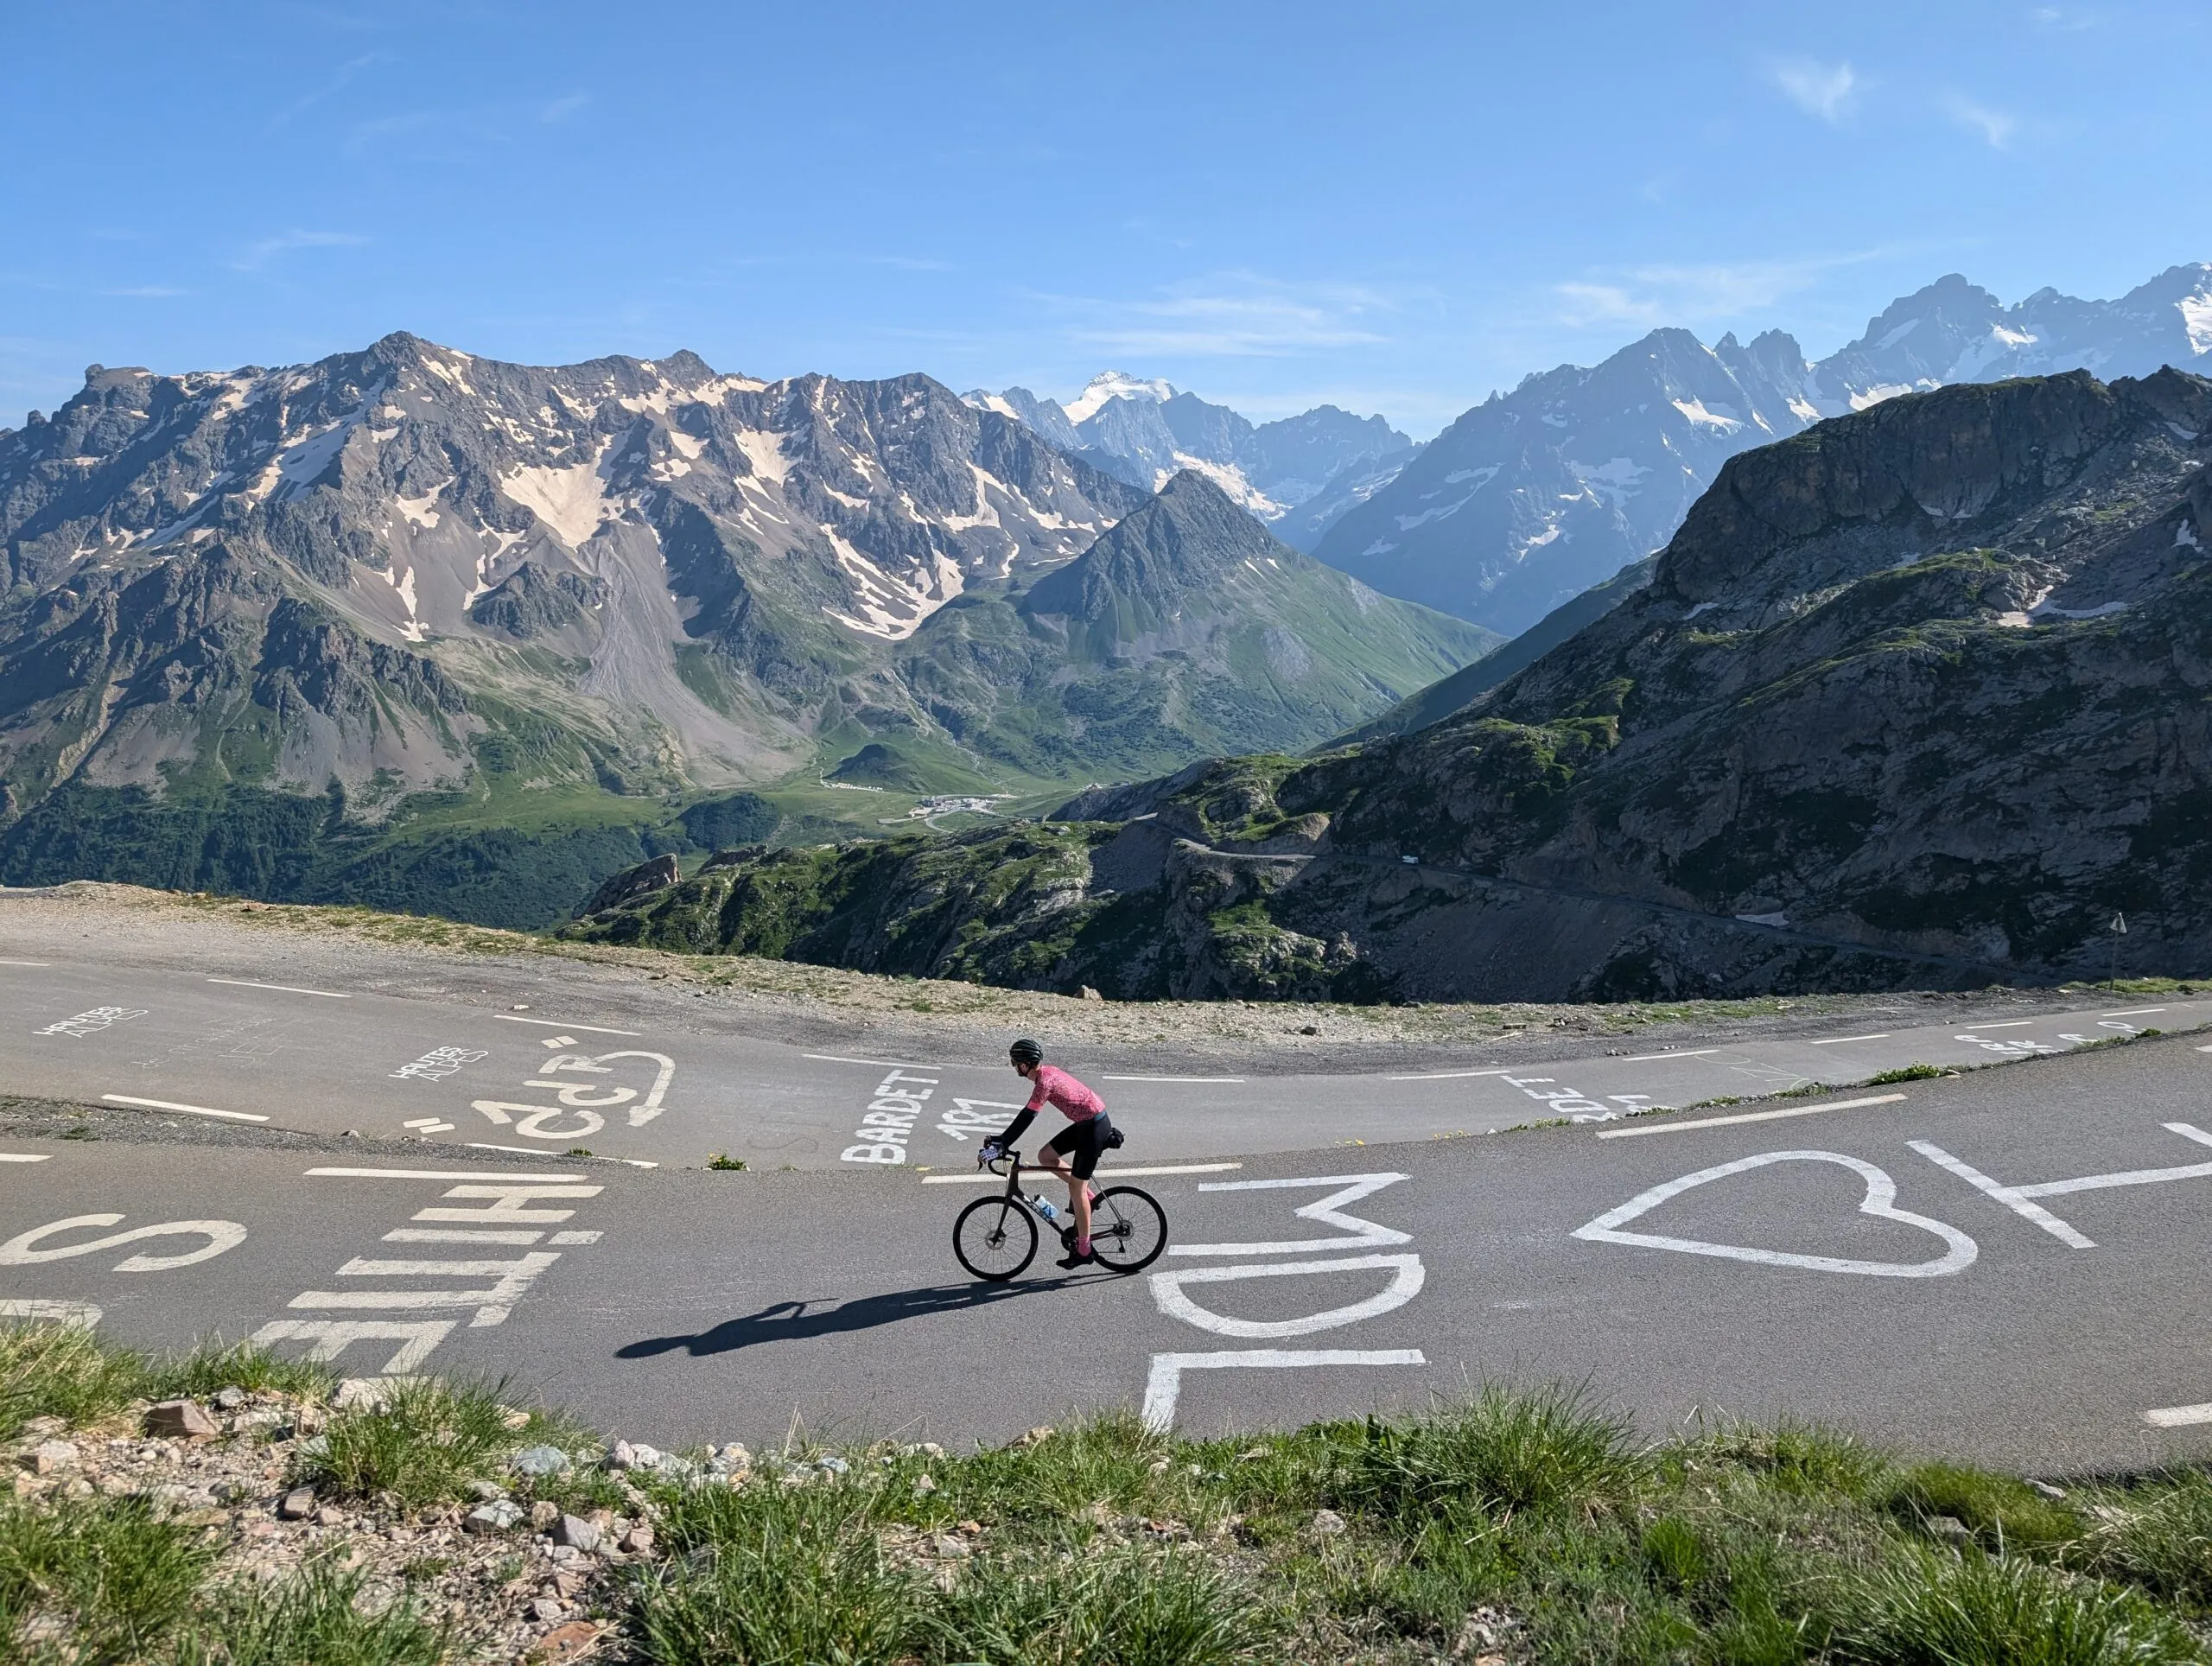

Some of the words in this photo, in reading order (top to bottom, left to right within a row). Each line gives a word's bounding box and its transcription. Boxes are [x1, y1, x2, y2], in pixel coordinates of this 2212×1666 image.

[32, 1006, 122, 1035] HAUTES
[63, 1008, 149, 1038] ALPES
[387, 1046, 461, 1079] HAUTES
[416, 1048, 488, 1083] ALPES
[840, 1070, 939, 1164] BARDET
[935, 1097, 1027, 1141] 181
